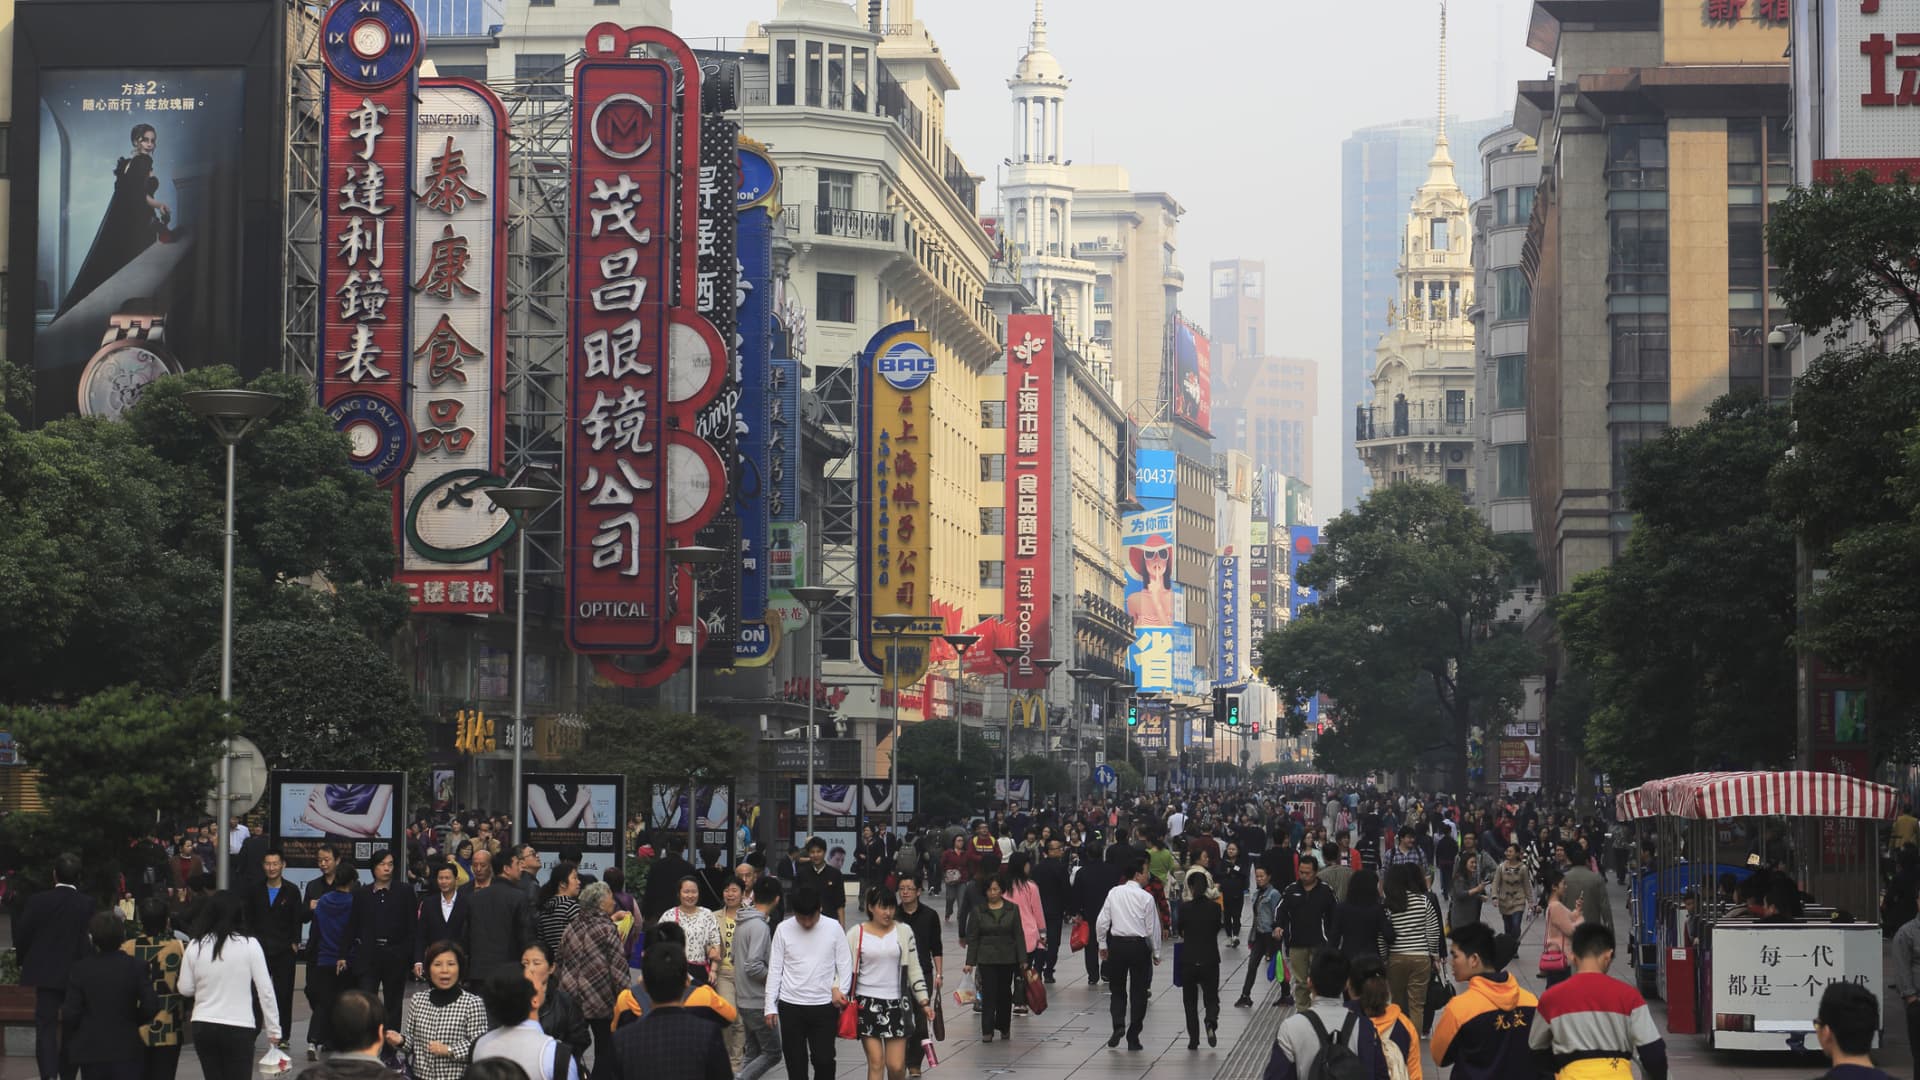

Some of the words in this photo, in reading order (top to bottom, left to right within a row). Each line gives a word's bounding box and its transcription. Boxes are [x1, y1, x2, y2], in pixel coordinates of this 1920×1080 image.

[416, 135, 487, 454] 泰康食品
[580, 174, 653, 576] 茂昌眼镜公司
[878, 357, 936, 373] BAC
[1017, 371, 1039, 557] 上海市第一食品商店
[1131, 514, 1174, 534] 为你而
[1019, 566, 1035, 600] First
[579, 601, 649, 618] OPTICAL
[1018, 601, 1035, 676] Foodhall
[1134, 631, 1173, 688] 省
[1760, 944, 1834, 968] 每一代
